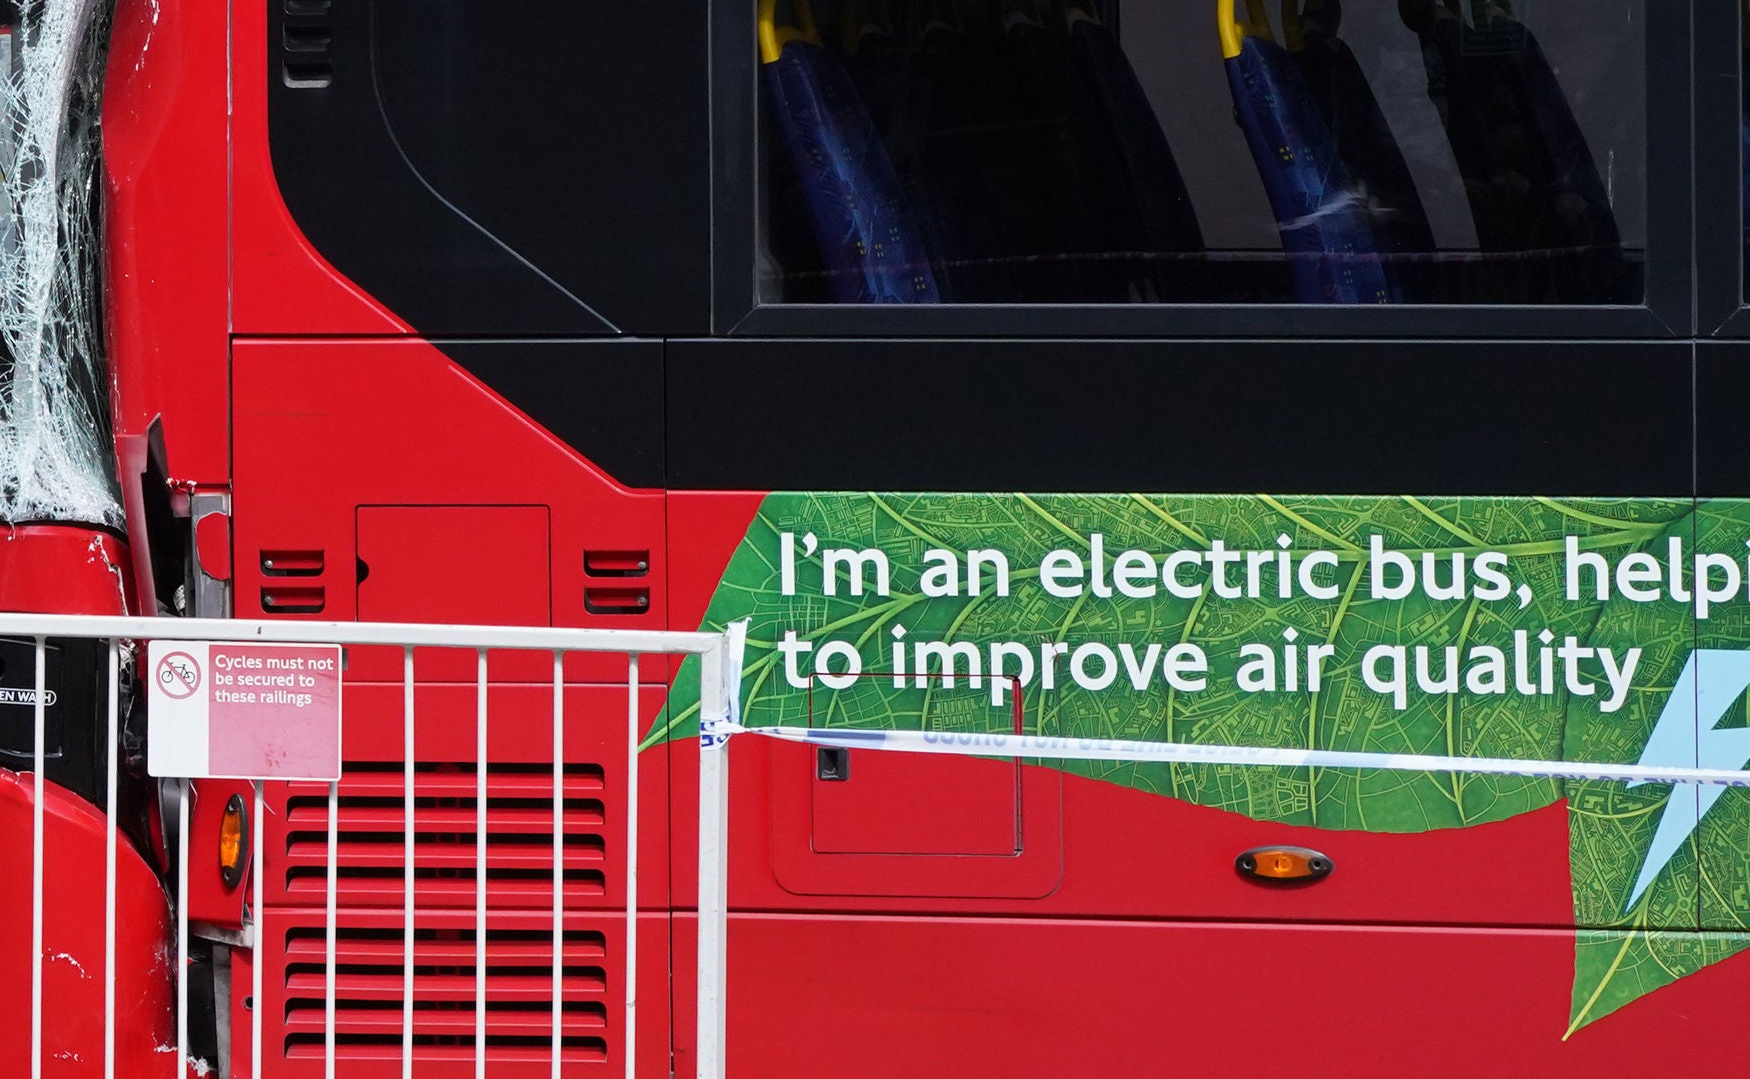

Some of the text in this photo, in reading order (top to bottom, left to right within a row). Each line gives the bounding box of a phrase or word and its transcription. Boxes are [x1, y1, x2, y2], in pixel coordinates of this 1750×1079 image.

[779, 532, 889, 597] I'm
[920, 547, 1009, 598] an
[1040, 533, 1339, 602] electric
[1370, 535, 1532, 611] bus,
[215, 654, 333, 670] Cycles must not
[778, 624, 1641, 713] to improve air quality
[215, 672, 315, 687] be secured to
[17, 691, 51, 703] WAH
[215, 690, 312, 707] these railings
